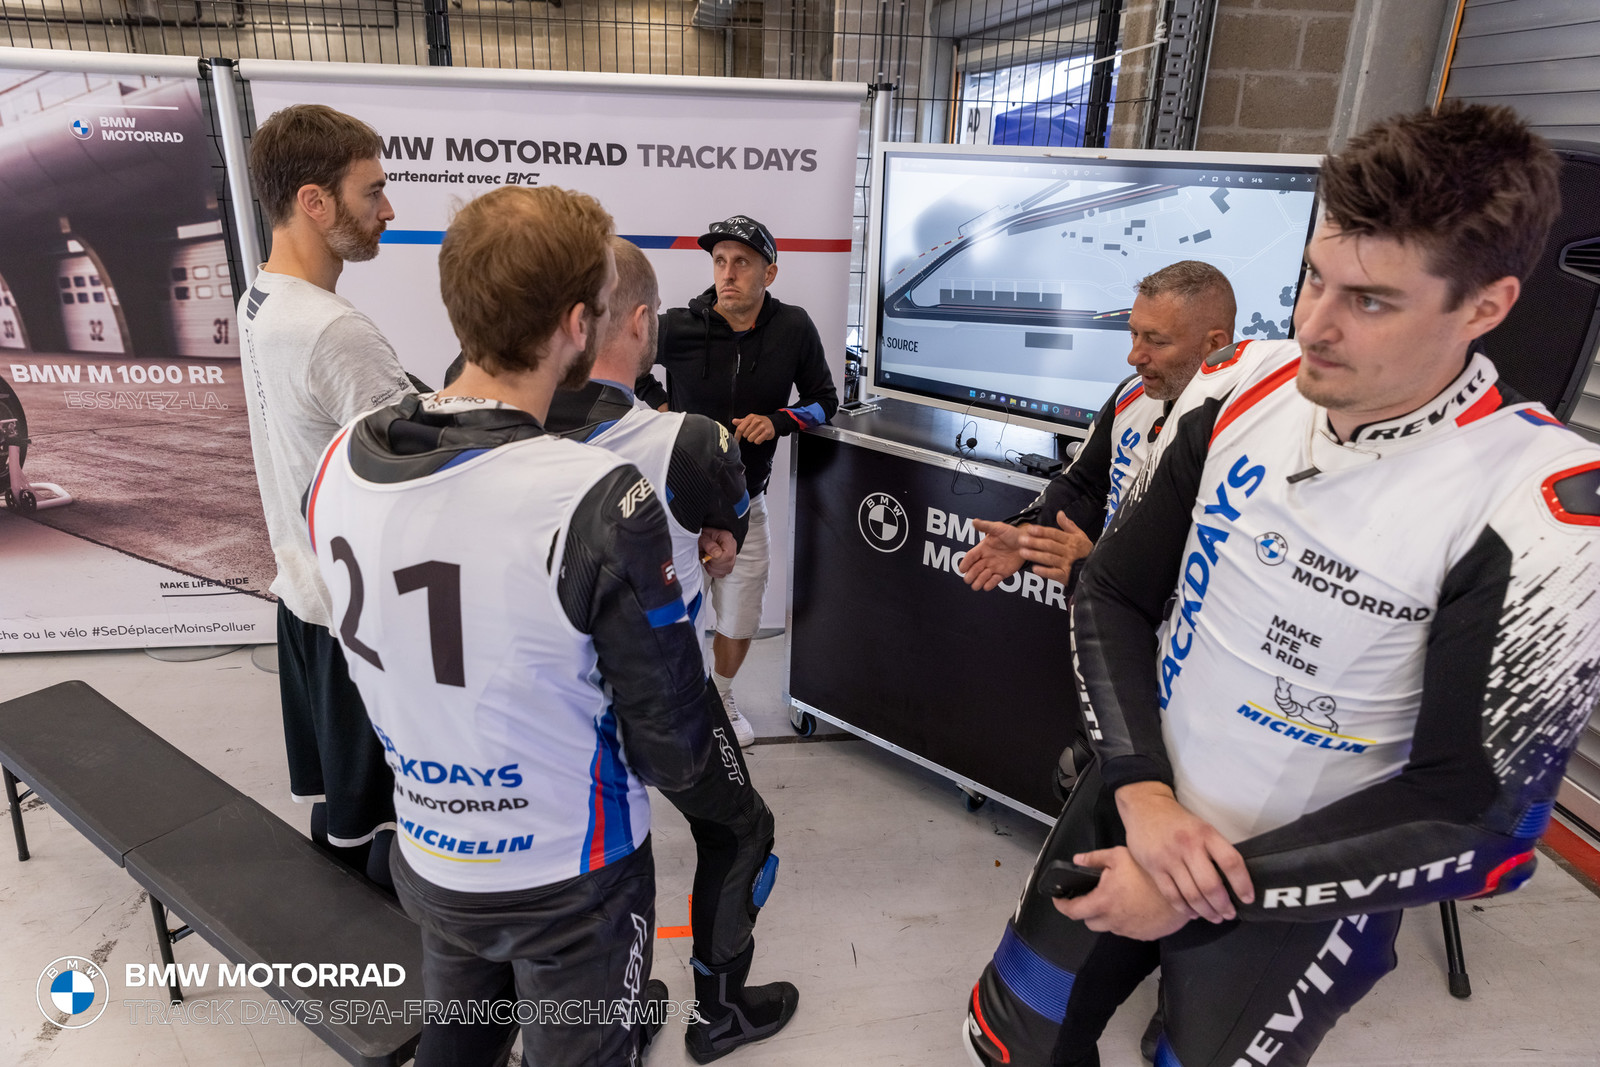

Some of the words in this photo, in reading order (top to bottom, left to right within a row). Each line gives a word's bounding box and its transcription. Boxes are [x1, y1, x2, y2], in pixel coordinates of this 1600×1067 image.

[99, 116, 136, 128] BMW
[101, 130, 184, 143] MOTORRAD
[379, 135, 434, 161] MW
[446, 137, 628, 166] MOTORRAD
[637, 143, 737, 170] TRACK
[743, 147, 818, 173] DAYS
[467, 174, 501, 185] avec
[505, 172, 540, 185] BMC
[212, 318, 230, 345] 31
[886, 336, 919, 353] SOURCE
[9, 364, 81, 383] BMW
[87, 365, 114, 384] M
[117, 365, 184, 384] 1000
[187, 365, 225, 384] RR
[64, 390, 229, 410] ESSAYEZ-LA.
[866, 496, 903, 517] BMW
[926, 506, 988, 546] BM
[1298, 548, 1359, 583] BMW
[160, 580, 190, 589] MAKE
[191, 580, 214, 588] LIFE
[225, 577, 249, 586] RIDE
[1291, 566, 1430, 622] MOTORRAD
[330, 535, 466, 688] 21
[23, 632, 40, 640] ou
[44, 629, 56, 639] le
[60, 626, 88, 638] vélo
[92, 621, 256, 638] #SeDéplacerMoinsPolluer
[1265, 628, 1301, 654] LIFE
[1271, 614, 1322, 649] MAKE
[1260, 642, 1272, 655] A
[1275, 649, 1318, 676] RIDE
[1236, 703, 1370, 754] MICHELIN
[408, 789, 529, 814] MOTORRAD
[399, 816, 535, 855] MICHELIN
[1263, 850, 1476, 909] REV'IT!
